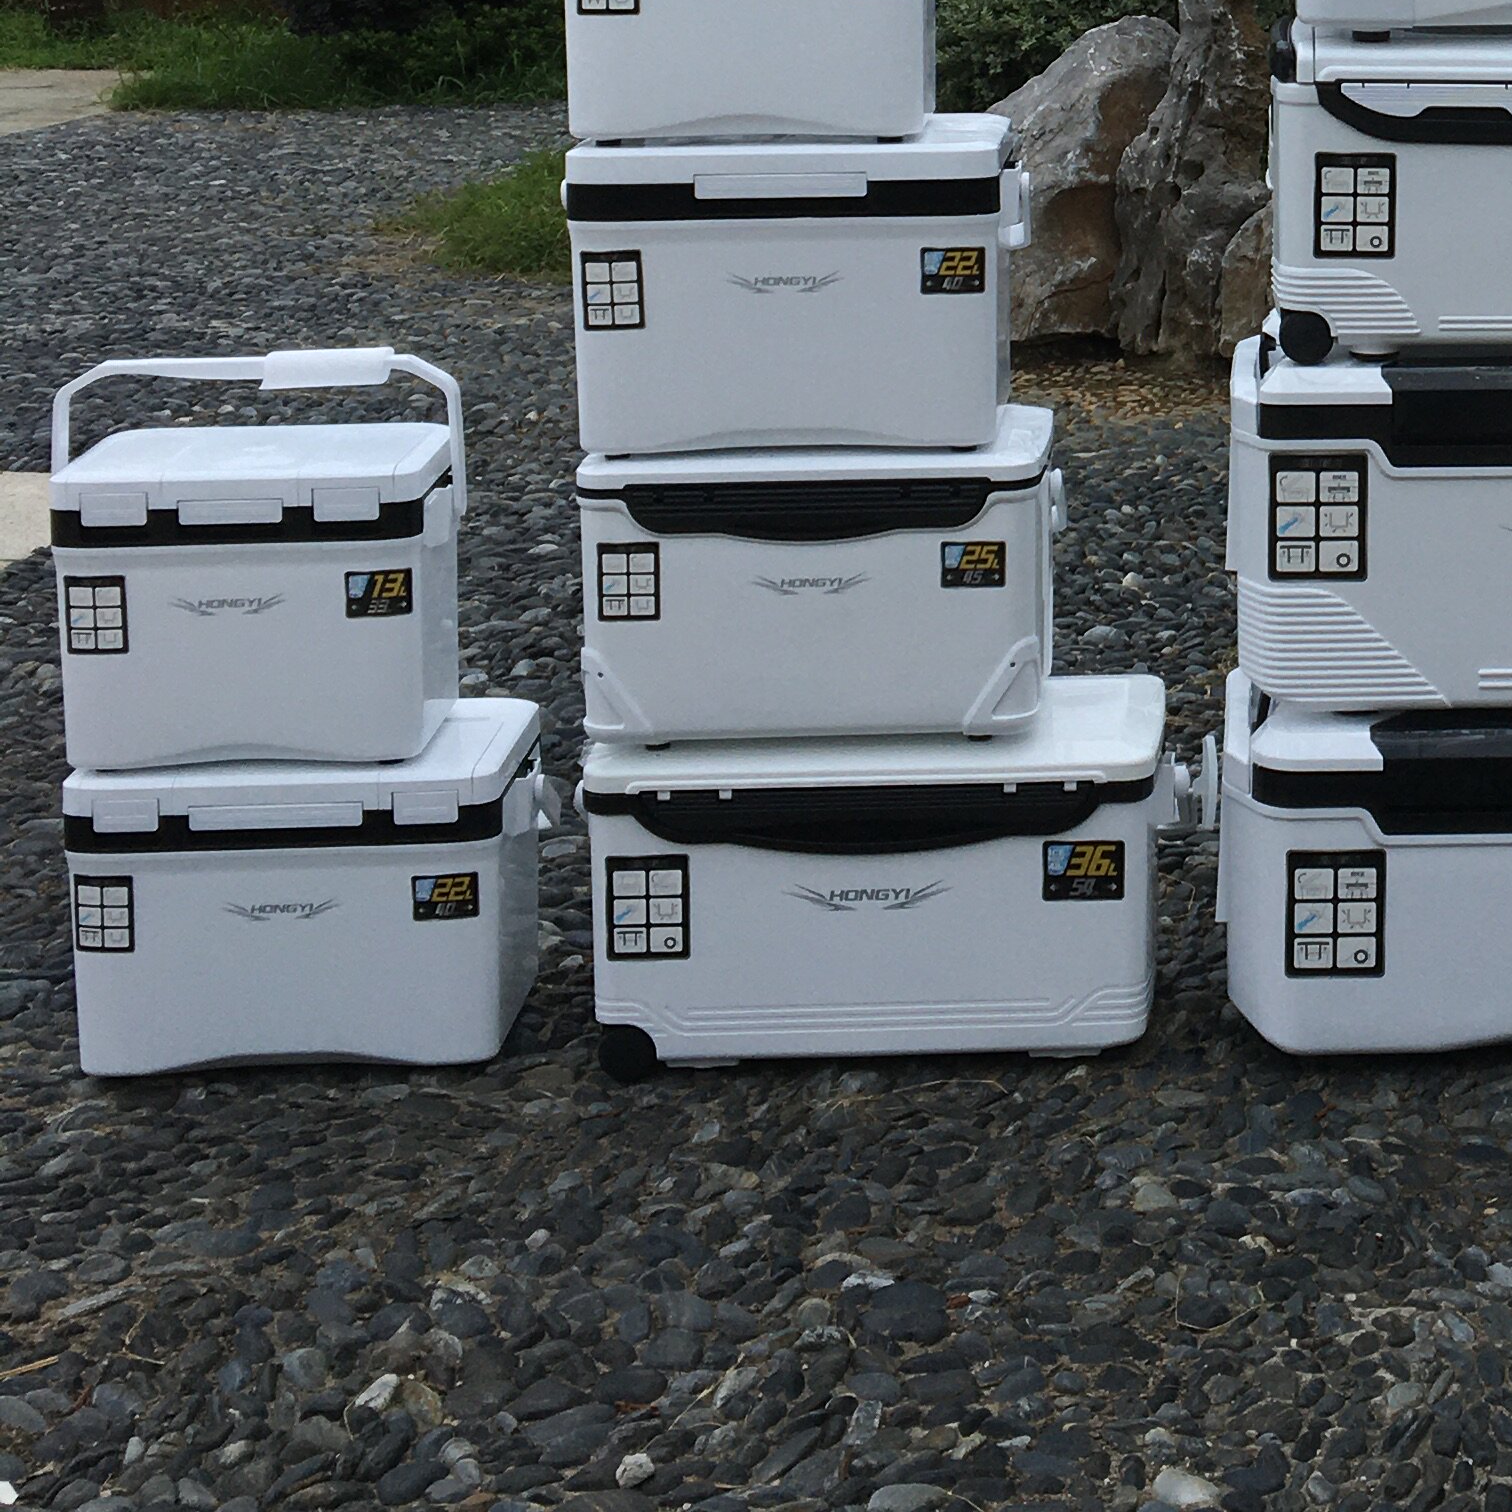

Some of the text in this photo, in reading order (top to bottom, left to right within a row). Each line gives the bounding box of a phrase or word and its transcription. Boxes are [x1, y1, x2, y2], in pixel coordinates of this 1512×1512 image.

[938, 251, 979, 276] 22L
[754, 276, 818, 286] HONGYI
[960, 545, 1000, 569] 25L
[372, 573, 406, 598] 13L
[780, 578, 843, 588] HONGYI
[198, 597, 262, 608] HONGYI
[1066, 845, 1118, 877] 36L
[431, 877, 472, 902] 22L
[829, 888, 911, 901] HONGYI
[251, 904, 314, 914] HONGYI
